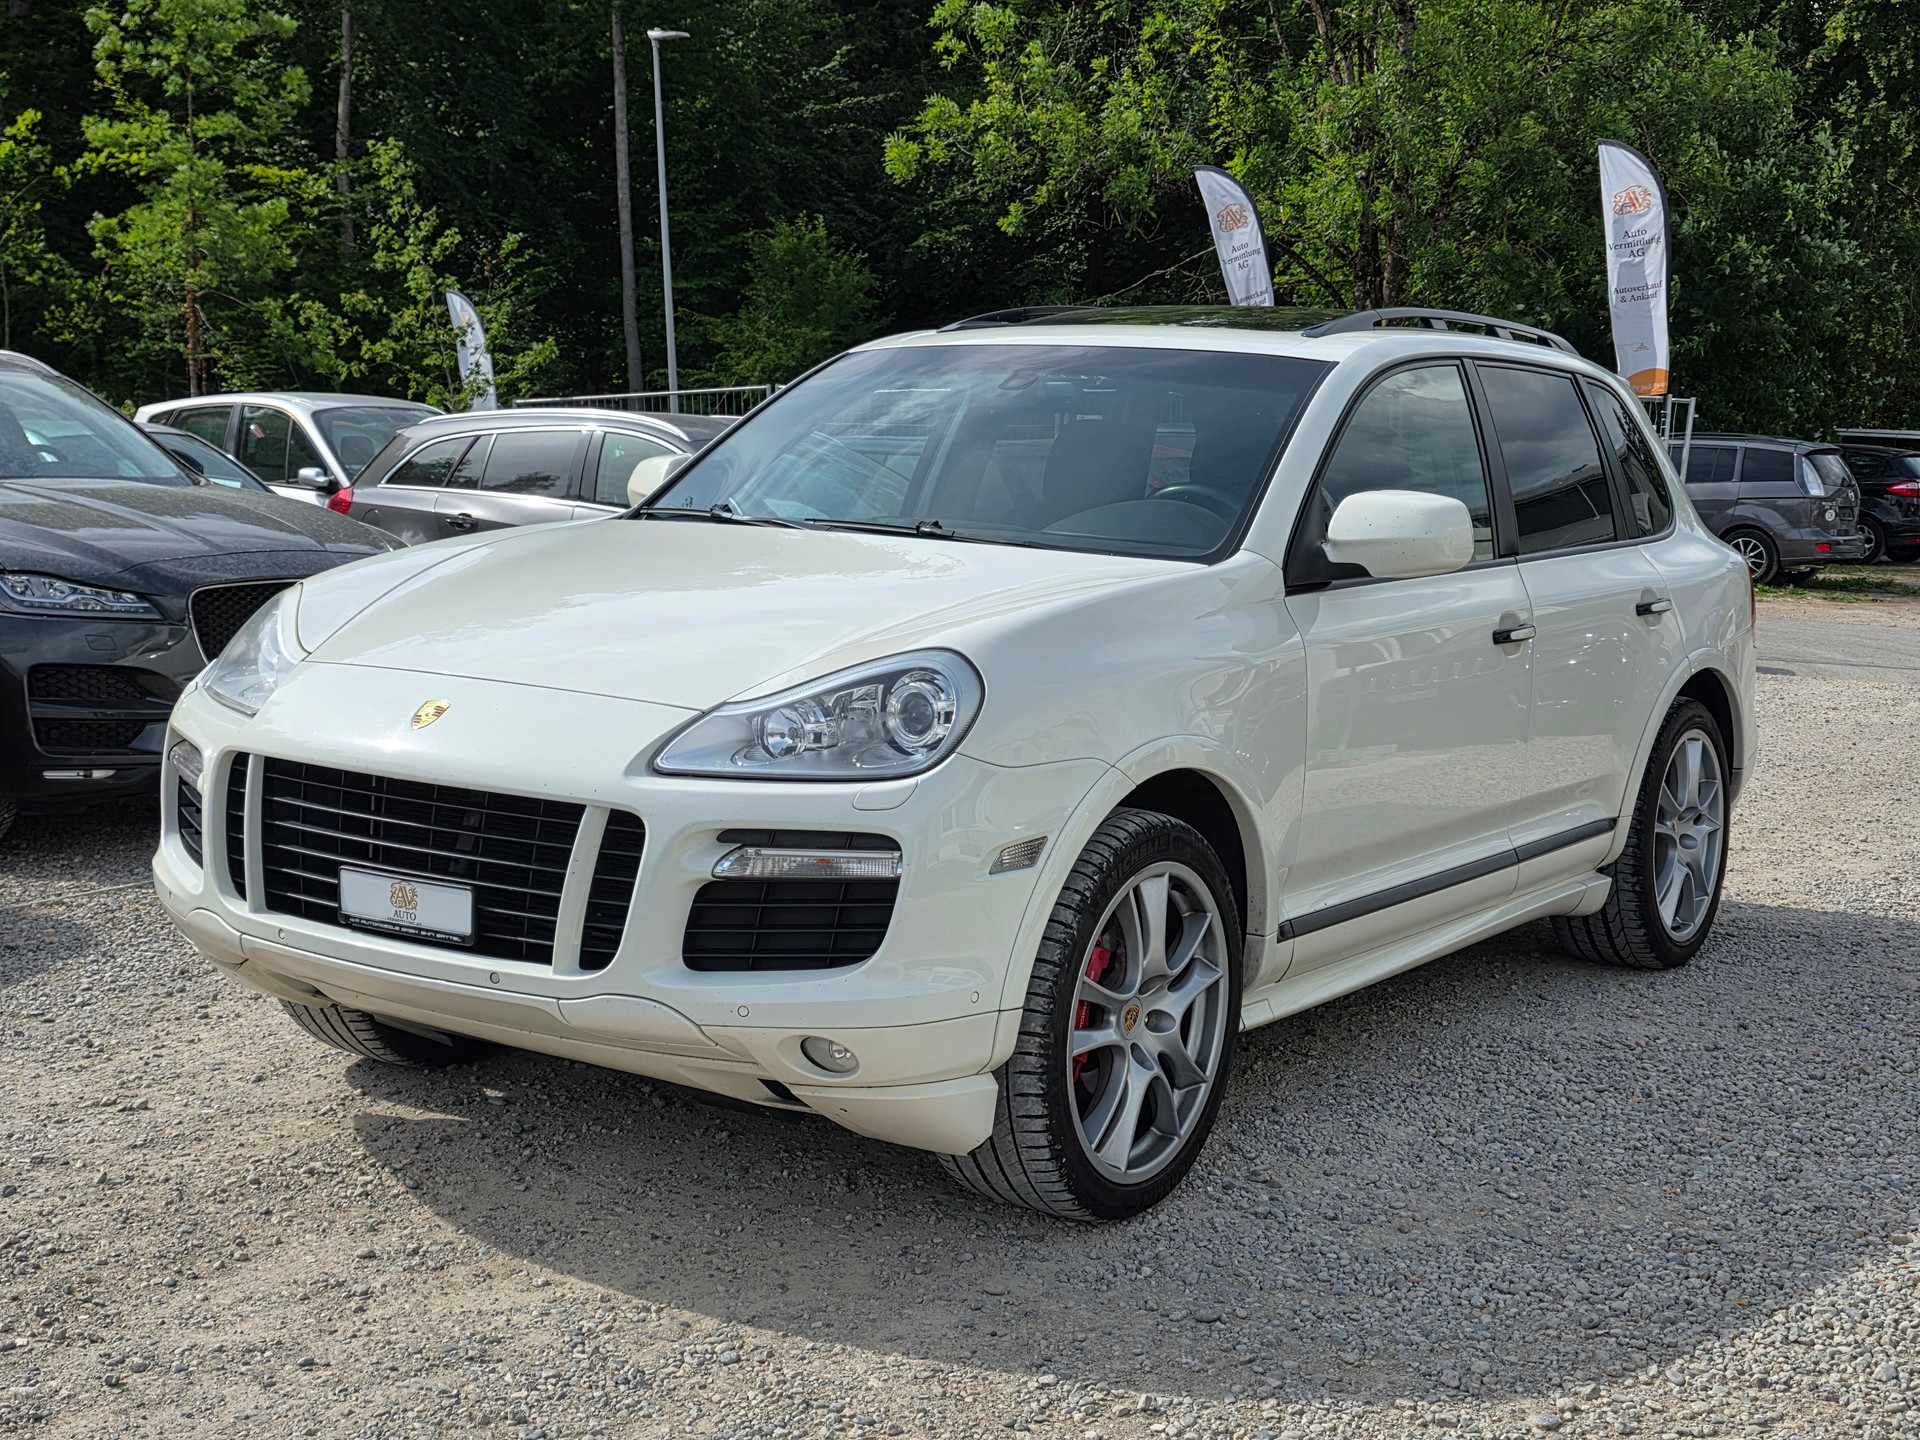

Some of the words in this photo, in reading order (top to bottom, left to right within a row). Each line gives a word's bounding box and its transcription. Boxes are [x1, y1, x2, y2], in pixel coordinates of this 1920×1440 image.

[1622, 228, 1647, 239] Auto
[1231, 242, 1249, 254] Auto
[1608, 236, 1662, 251] Vermittlung
[1222, 247, 1261, 266] Vermittlung
[1628, 247, 1645, 259] AG
[1237, 260, 1250, 271] AG
[1613, 280, 1663, 295] Autoverkauf
[1620, 295, 1628, 303] &
[1629, 290, 1658, 303] Ankauf
[393, 909, 416, 921] AUTO
